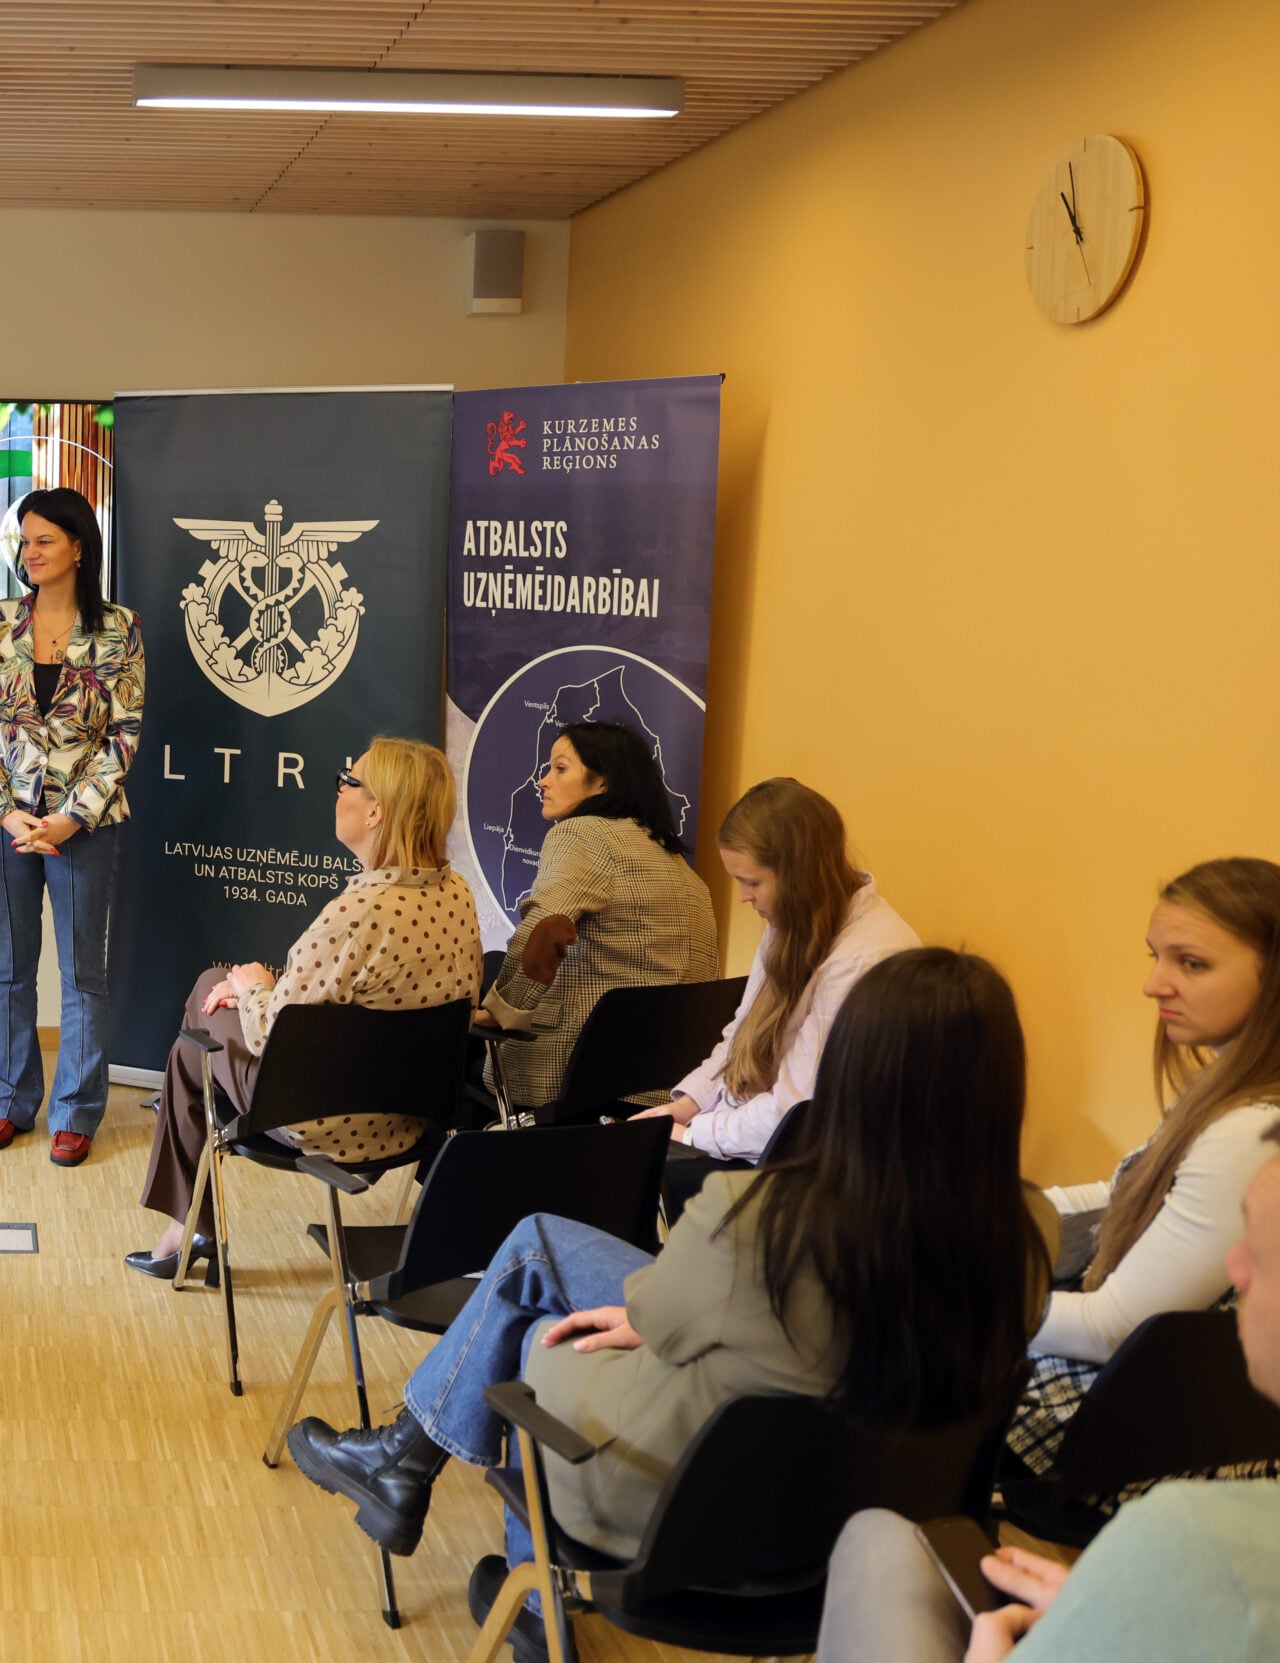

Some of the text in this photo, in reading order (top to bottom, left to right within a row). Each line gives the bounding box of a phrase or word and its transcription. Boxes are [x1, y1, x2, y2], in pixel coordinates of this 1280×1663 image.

[543, 417, 638, 434] KURZEMES
[542, 434, 660, 452] PLĀNOŠANAS
[542, 454, 618, 473] REĢIONS
[463, 520, 568, 559] ATBALSTS
[463, 564, 660, 618] UZŅĒMĒJDARBĪBAI
[524, 700, 550, 711] Ventspils
[164, 744, 353, 789] LTR
[165, 841, 233, 860] LATVIJAS
[237, 848, 319, 868] UZŅĒMĒJU
[522, 858, 540, 867] novad
[194, 863, 339, 890] UN ATBALSTS KOPŠ
[223, 885, 308, 906] 1934. GADA
